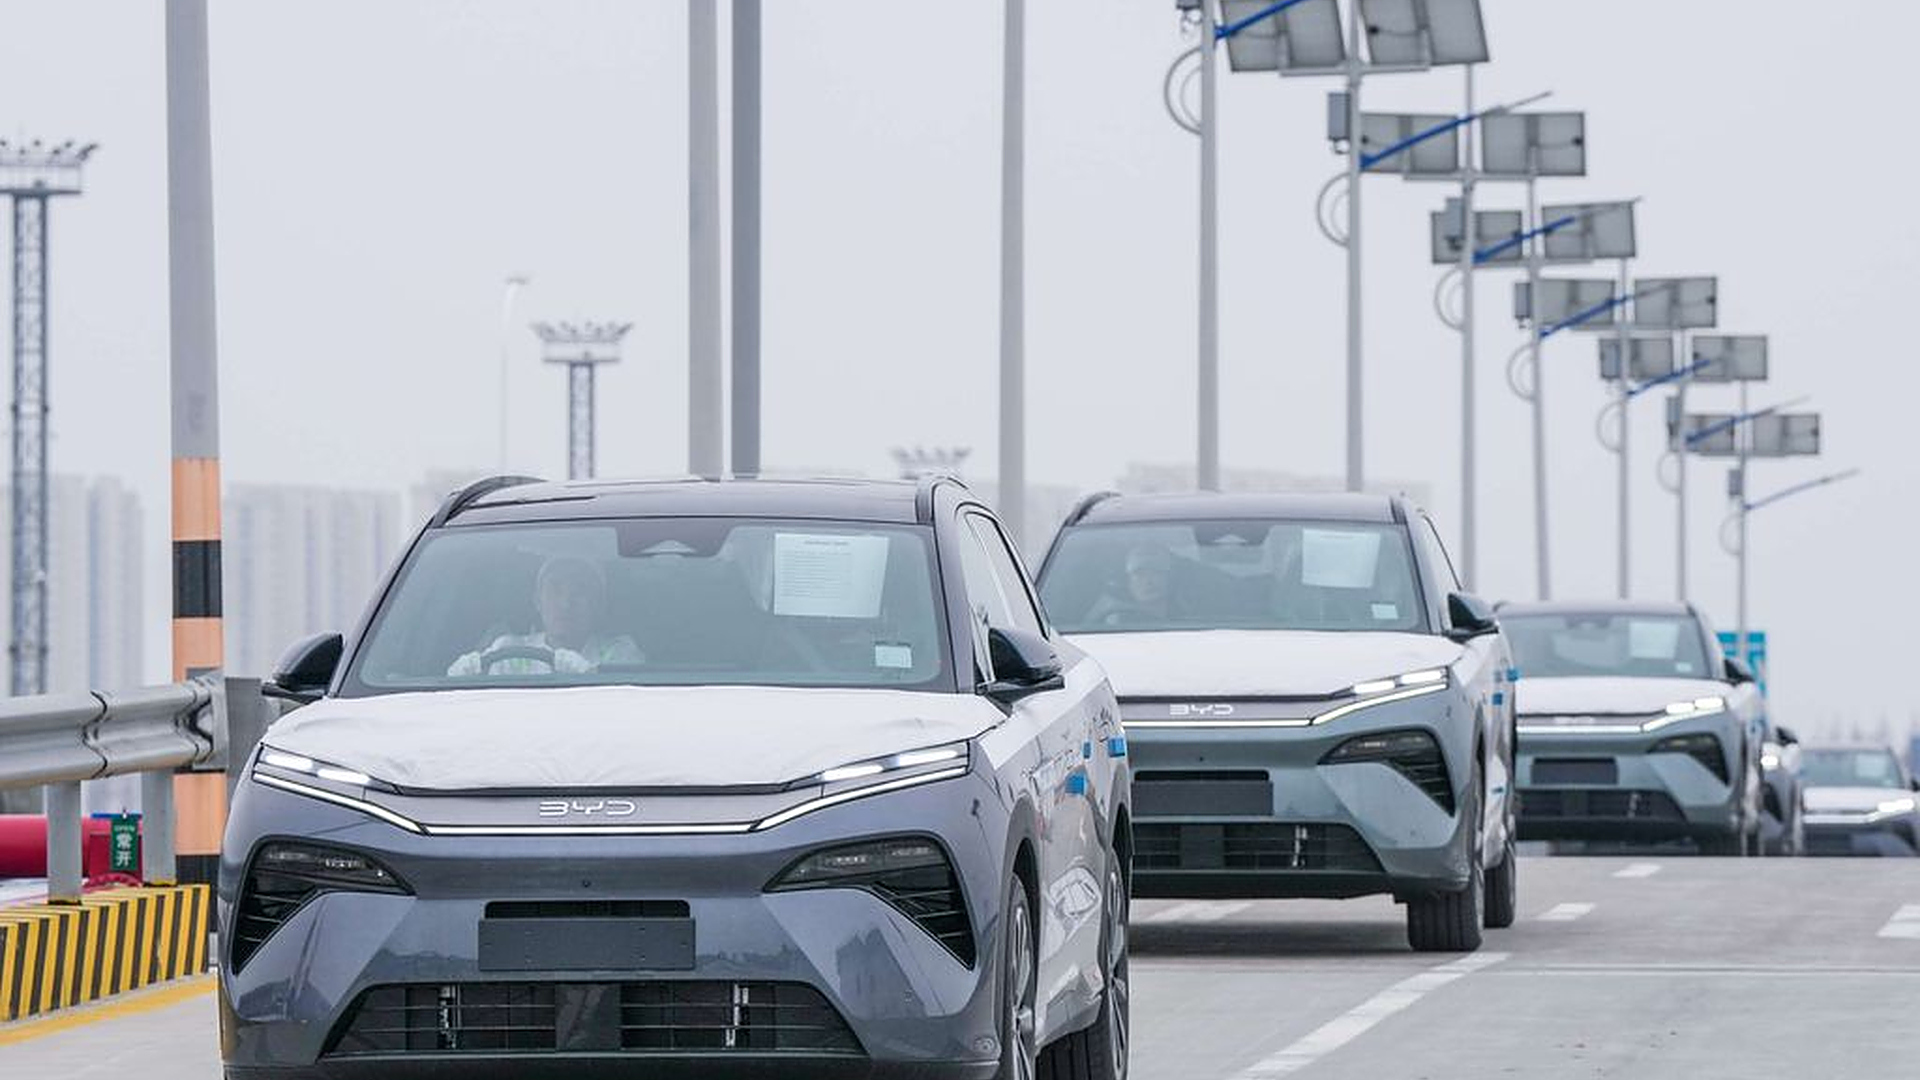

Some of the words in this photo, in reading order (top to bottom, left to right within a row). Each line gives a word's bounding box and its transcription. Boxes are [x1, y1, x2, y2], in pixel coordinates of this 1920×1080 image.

[1170, 704, 1233, 715] BYD
[539, 800, 636, 816] BYD
[116, 833, 132, 866] 常开
